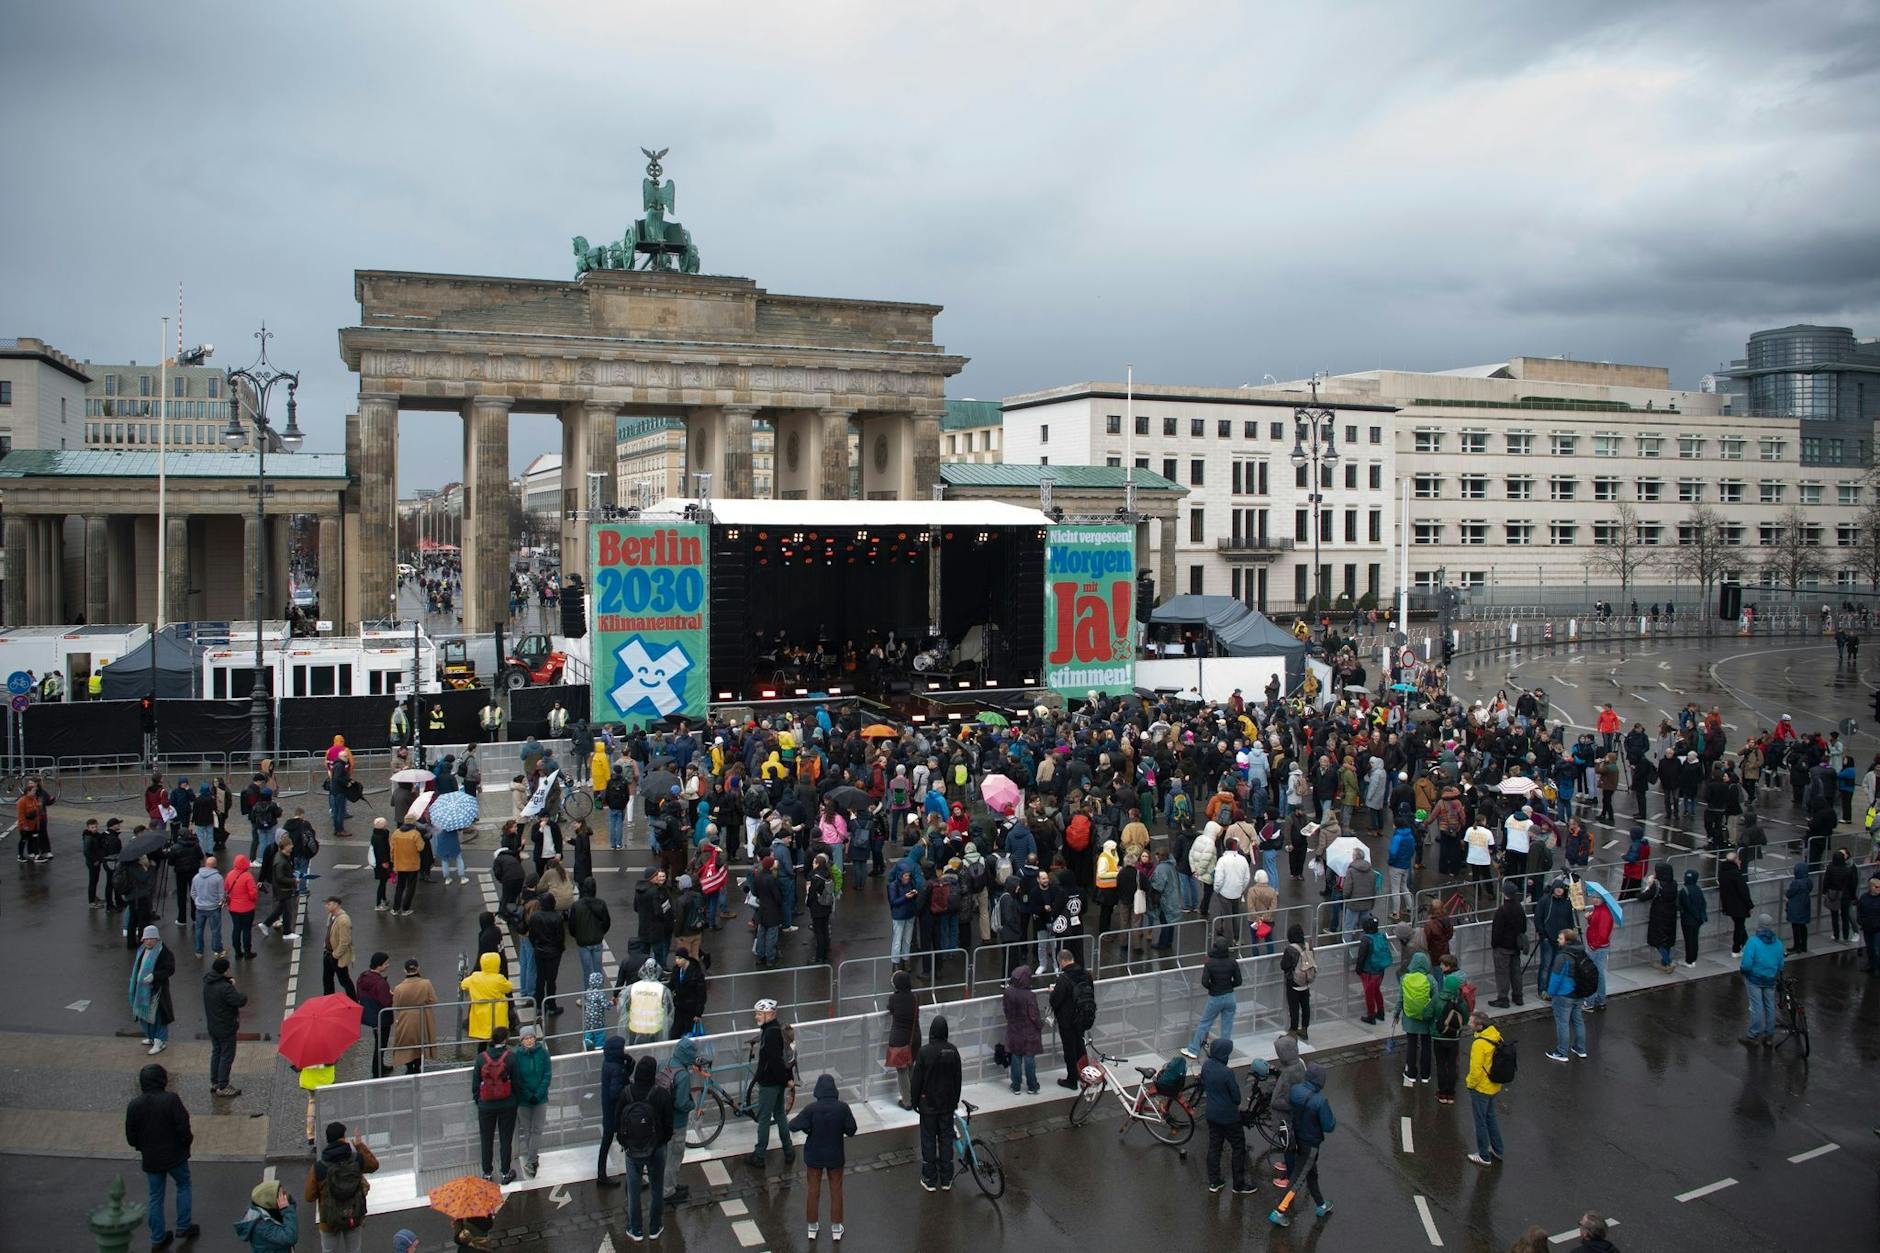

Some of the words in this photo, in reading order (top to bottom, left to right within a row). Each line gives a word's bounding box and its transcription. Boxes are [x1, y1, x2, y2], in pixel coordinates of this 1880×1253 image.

[598, 529, 703, 566] Berlin
[1050, 530, 1078, 544] Nicht
[1079, 530, 1132, 546] vergessen!
[1049, 546, 1132, 579] Morgen
[597, 567, 704, 613] 2030
[1083, 581, 1098, 593] mit
[598, 613, 703, 632] Klimaneutral
[1049, 581, 1132, 664] Ja!
[1050, 664, 1132, 688] stimmen!
